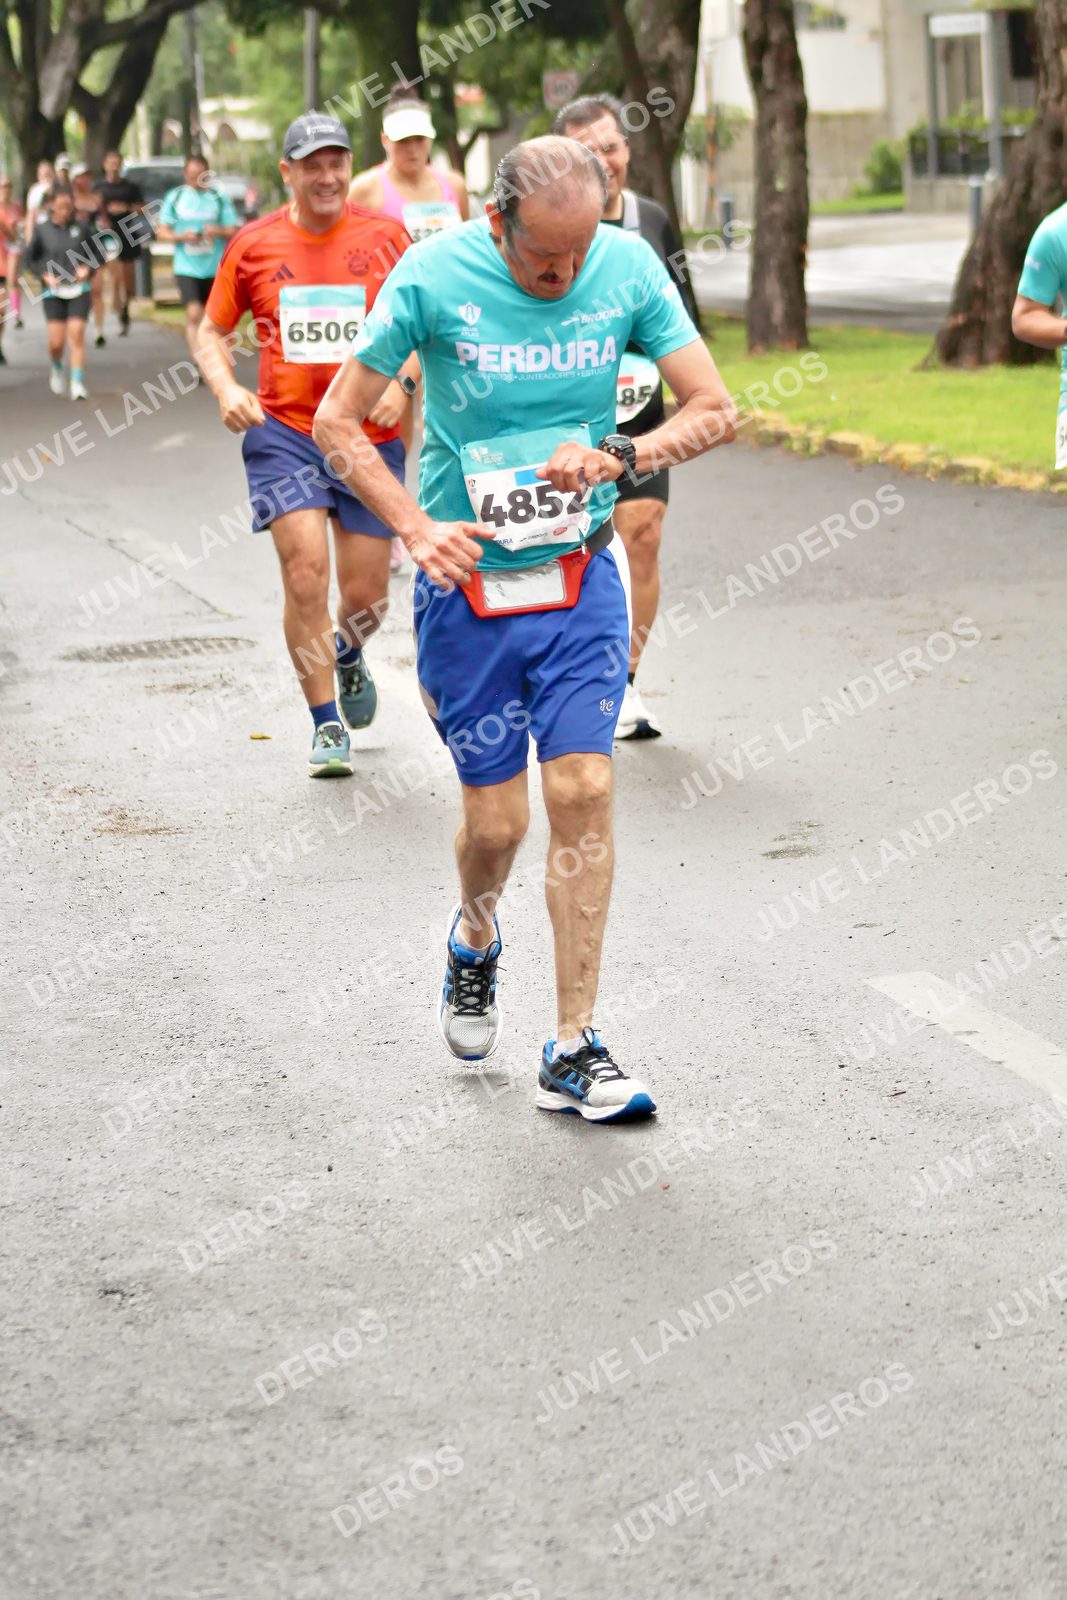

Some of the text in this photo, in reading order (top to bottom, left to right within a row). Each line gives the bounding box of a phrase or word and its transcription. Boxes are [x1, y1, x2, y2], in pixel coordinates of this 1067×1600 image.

[581, 308, 623, 324] BROOKS
[288, 321, 359, 344] 6506
[455, 336, 617, 374] PERDURA
[616, 385, 652, 407] 85
